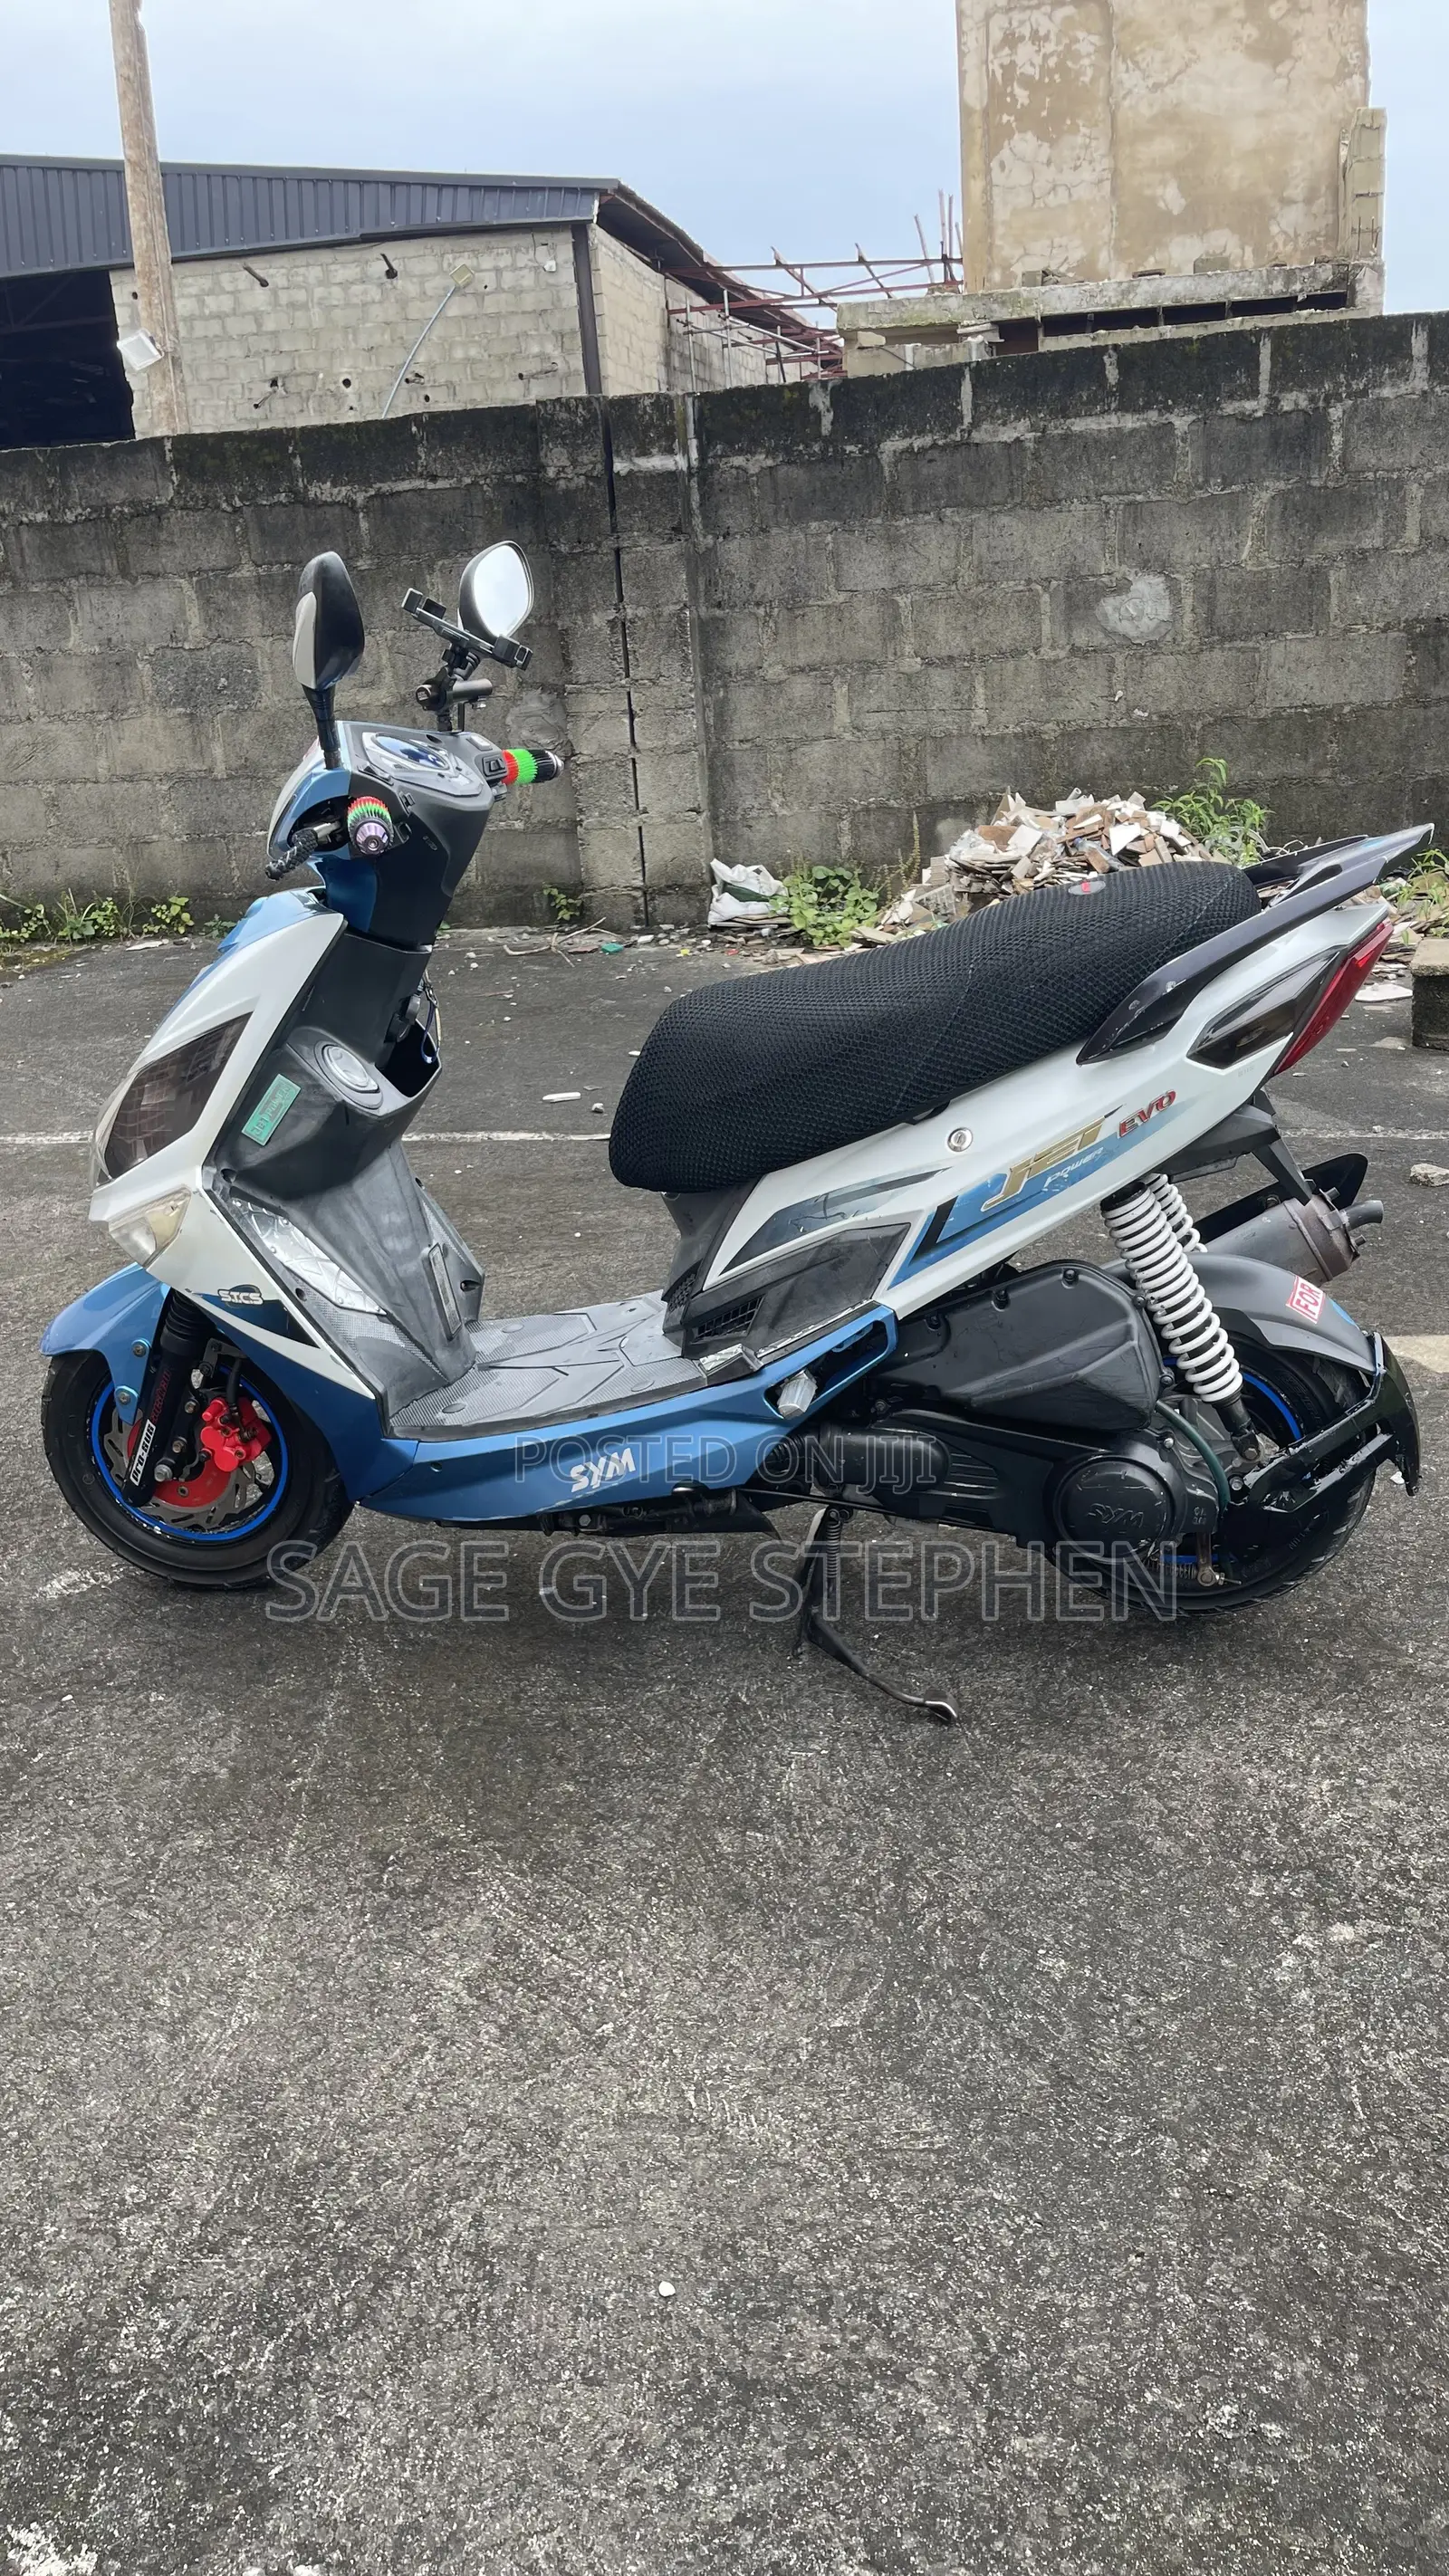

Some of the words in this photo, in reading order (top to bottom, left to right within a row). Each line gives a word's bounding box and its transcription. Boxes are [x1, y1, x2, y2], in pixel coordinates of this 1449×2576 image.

[981, 1110, 1114, 1211] JET
[1118, 1089, 1176, 1138] EVO
[1296, 1282, 1321, 1316] FOR
[570, 1447, 637, 1493] SYM
[1087, 1502, 1145, 1528] SYM
